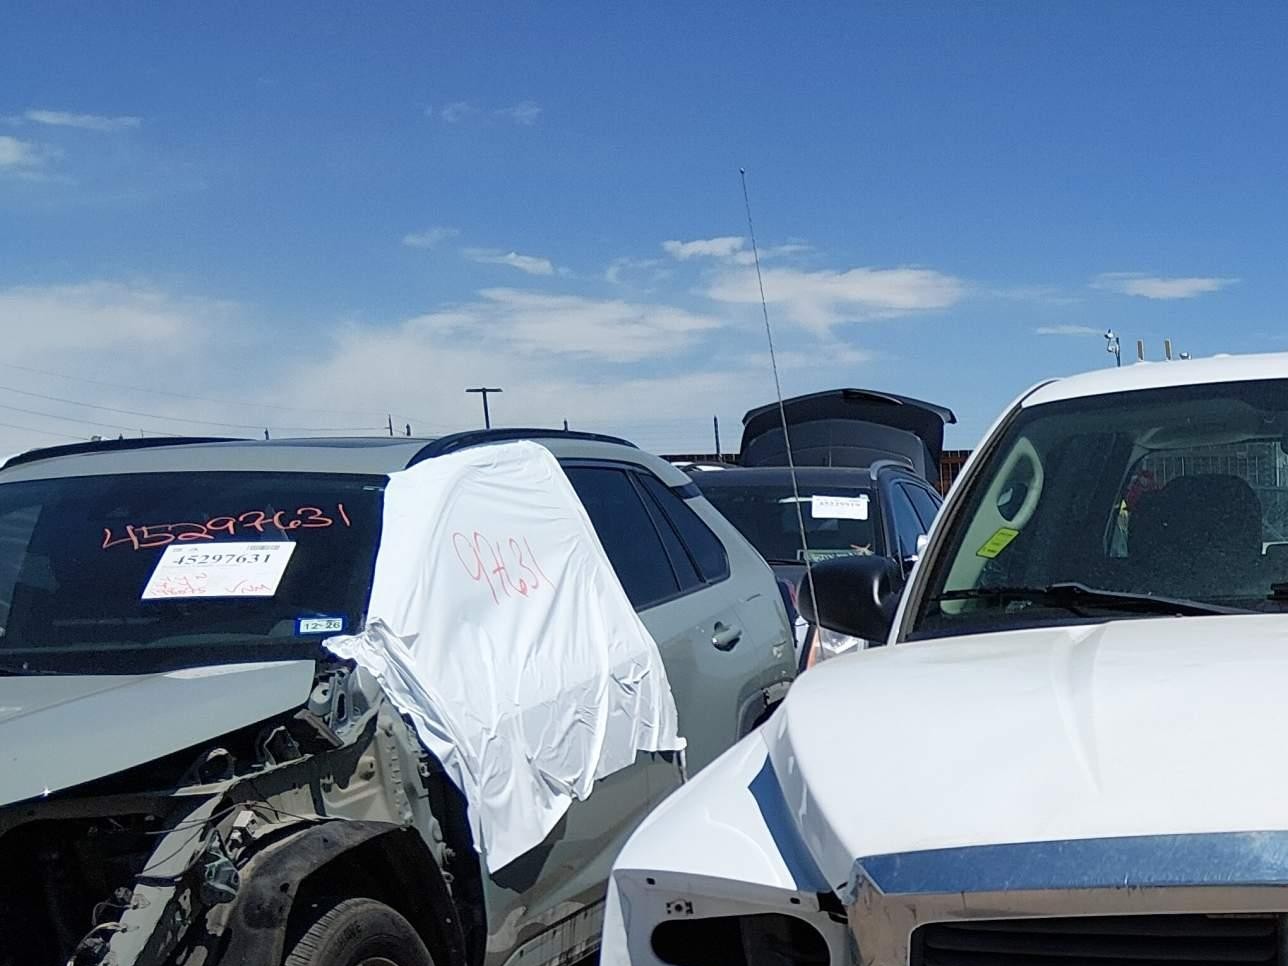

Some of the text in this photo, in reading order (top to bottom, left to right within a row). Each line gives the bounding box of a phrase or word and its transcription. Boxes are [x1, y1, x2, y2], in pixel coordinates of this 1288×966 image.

[102, 503, 351, 550] 45297631
[172, 553, 272, 566] 45297631
[452, 531, 556, 605] 97631
[305, 620, 341, 630] 12-26
